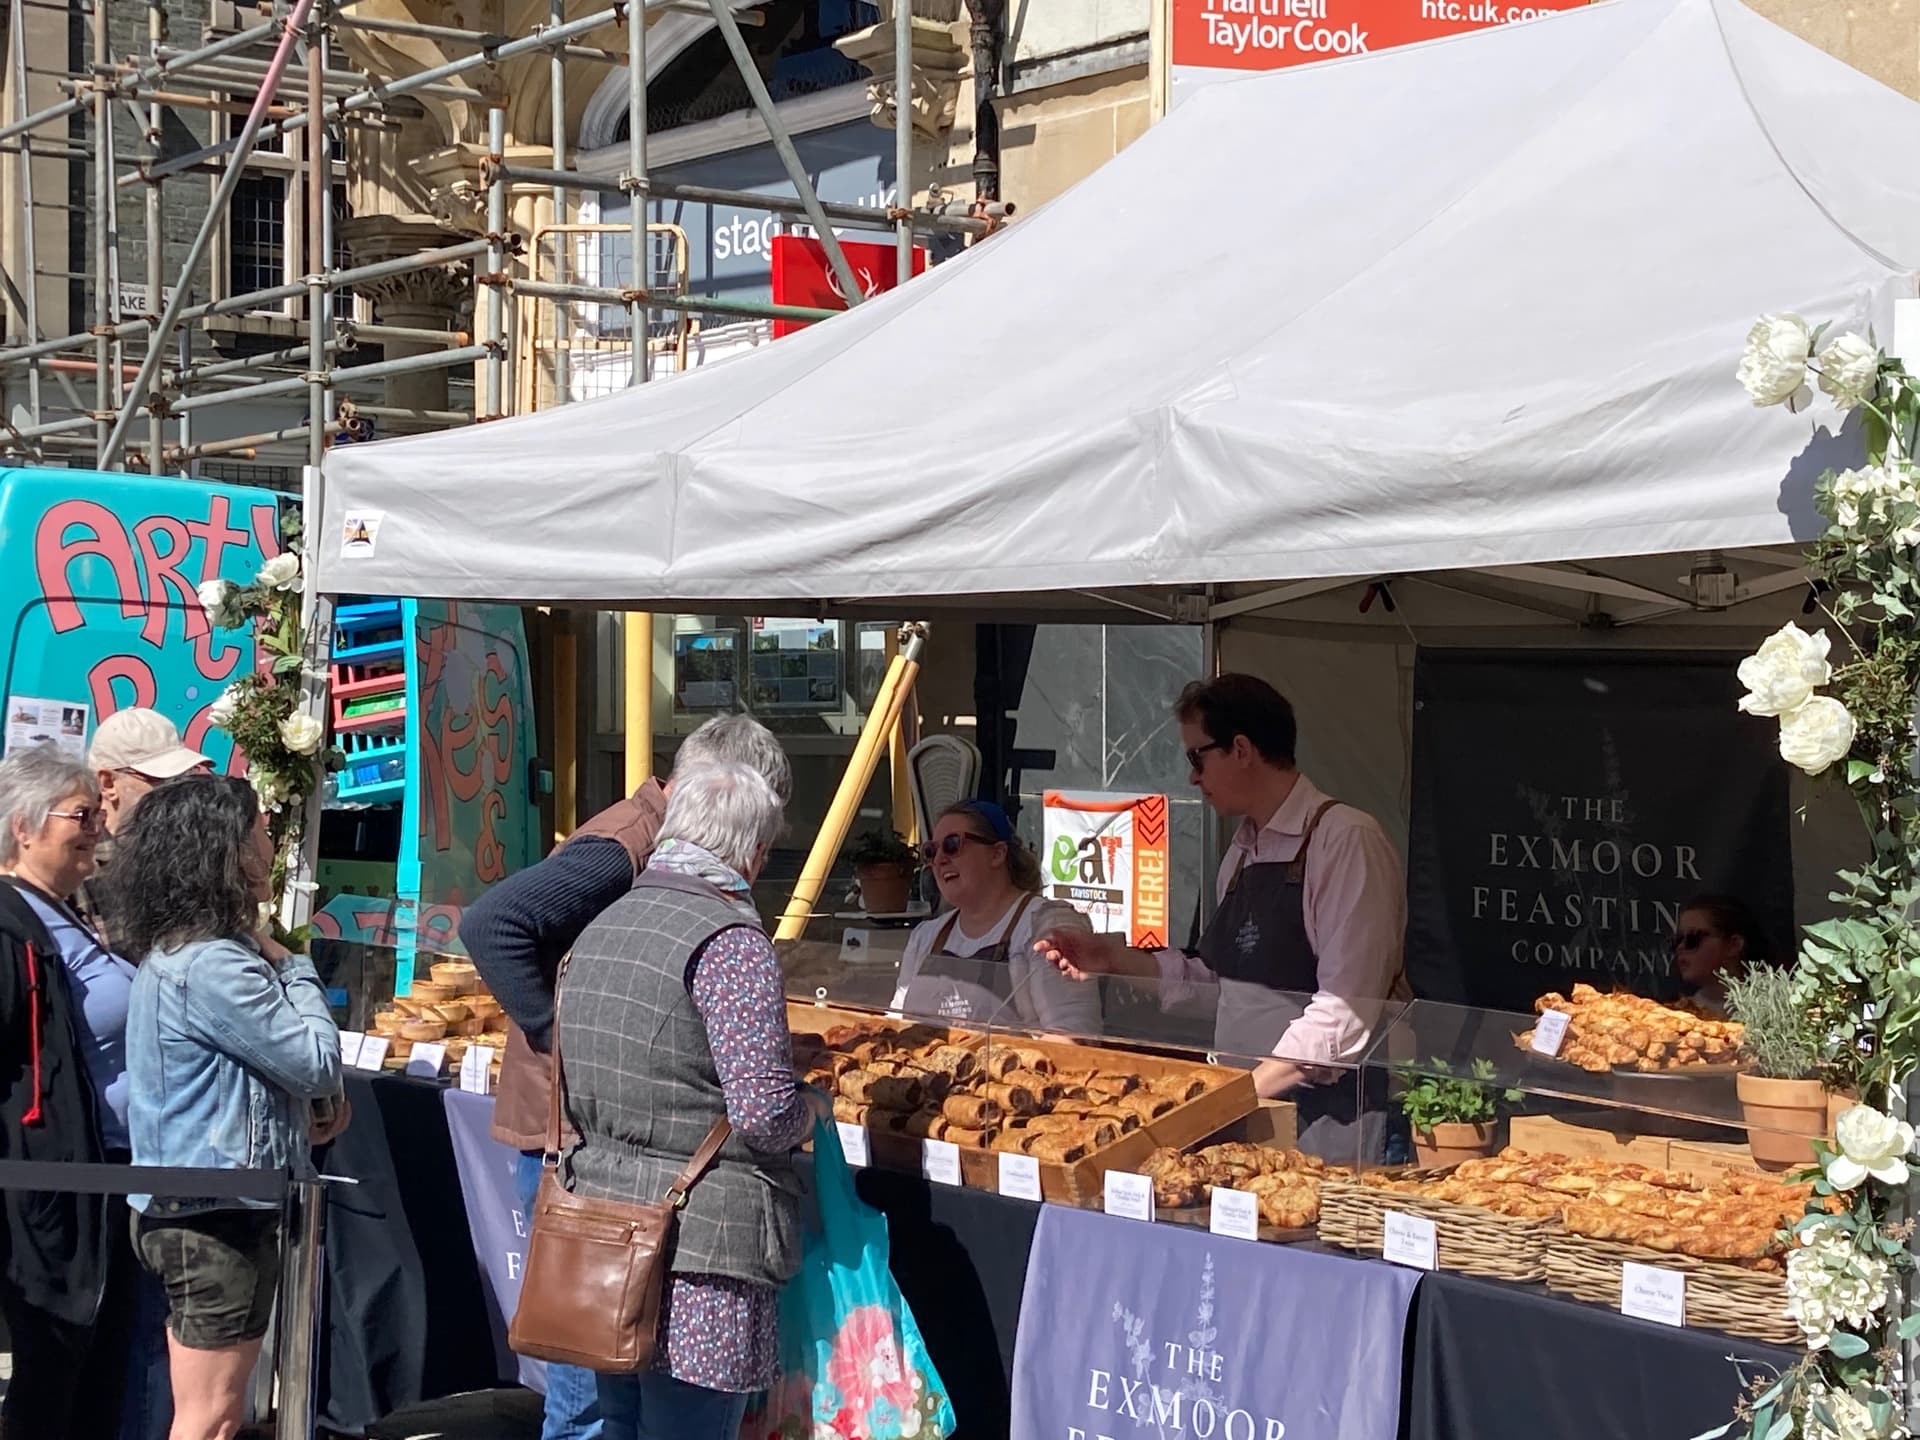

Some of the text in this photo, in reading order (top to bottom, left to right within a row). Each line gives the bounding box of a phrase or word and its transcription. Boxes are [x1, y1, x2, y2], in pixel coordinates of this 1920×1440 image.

[1200, 12, 1369, 54] Taylor Cook
[1561, 796, 1624, 823] THE
[1489, 833, 1702, 881] EXMOOR
[1137, 849, 1164, 926] HERE!
[1471, 886, 1682, 934] FEASTIN
[1511, 939, 1677, 977] COMPANY
[1165, 1341, 1225, 1383] THE
